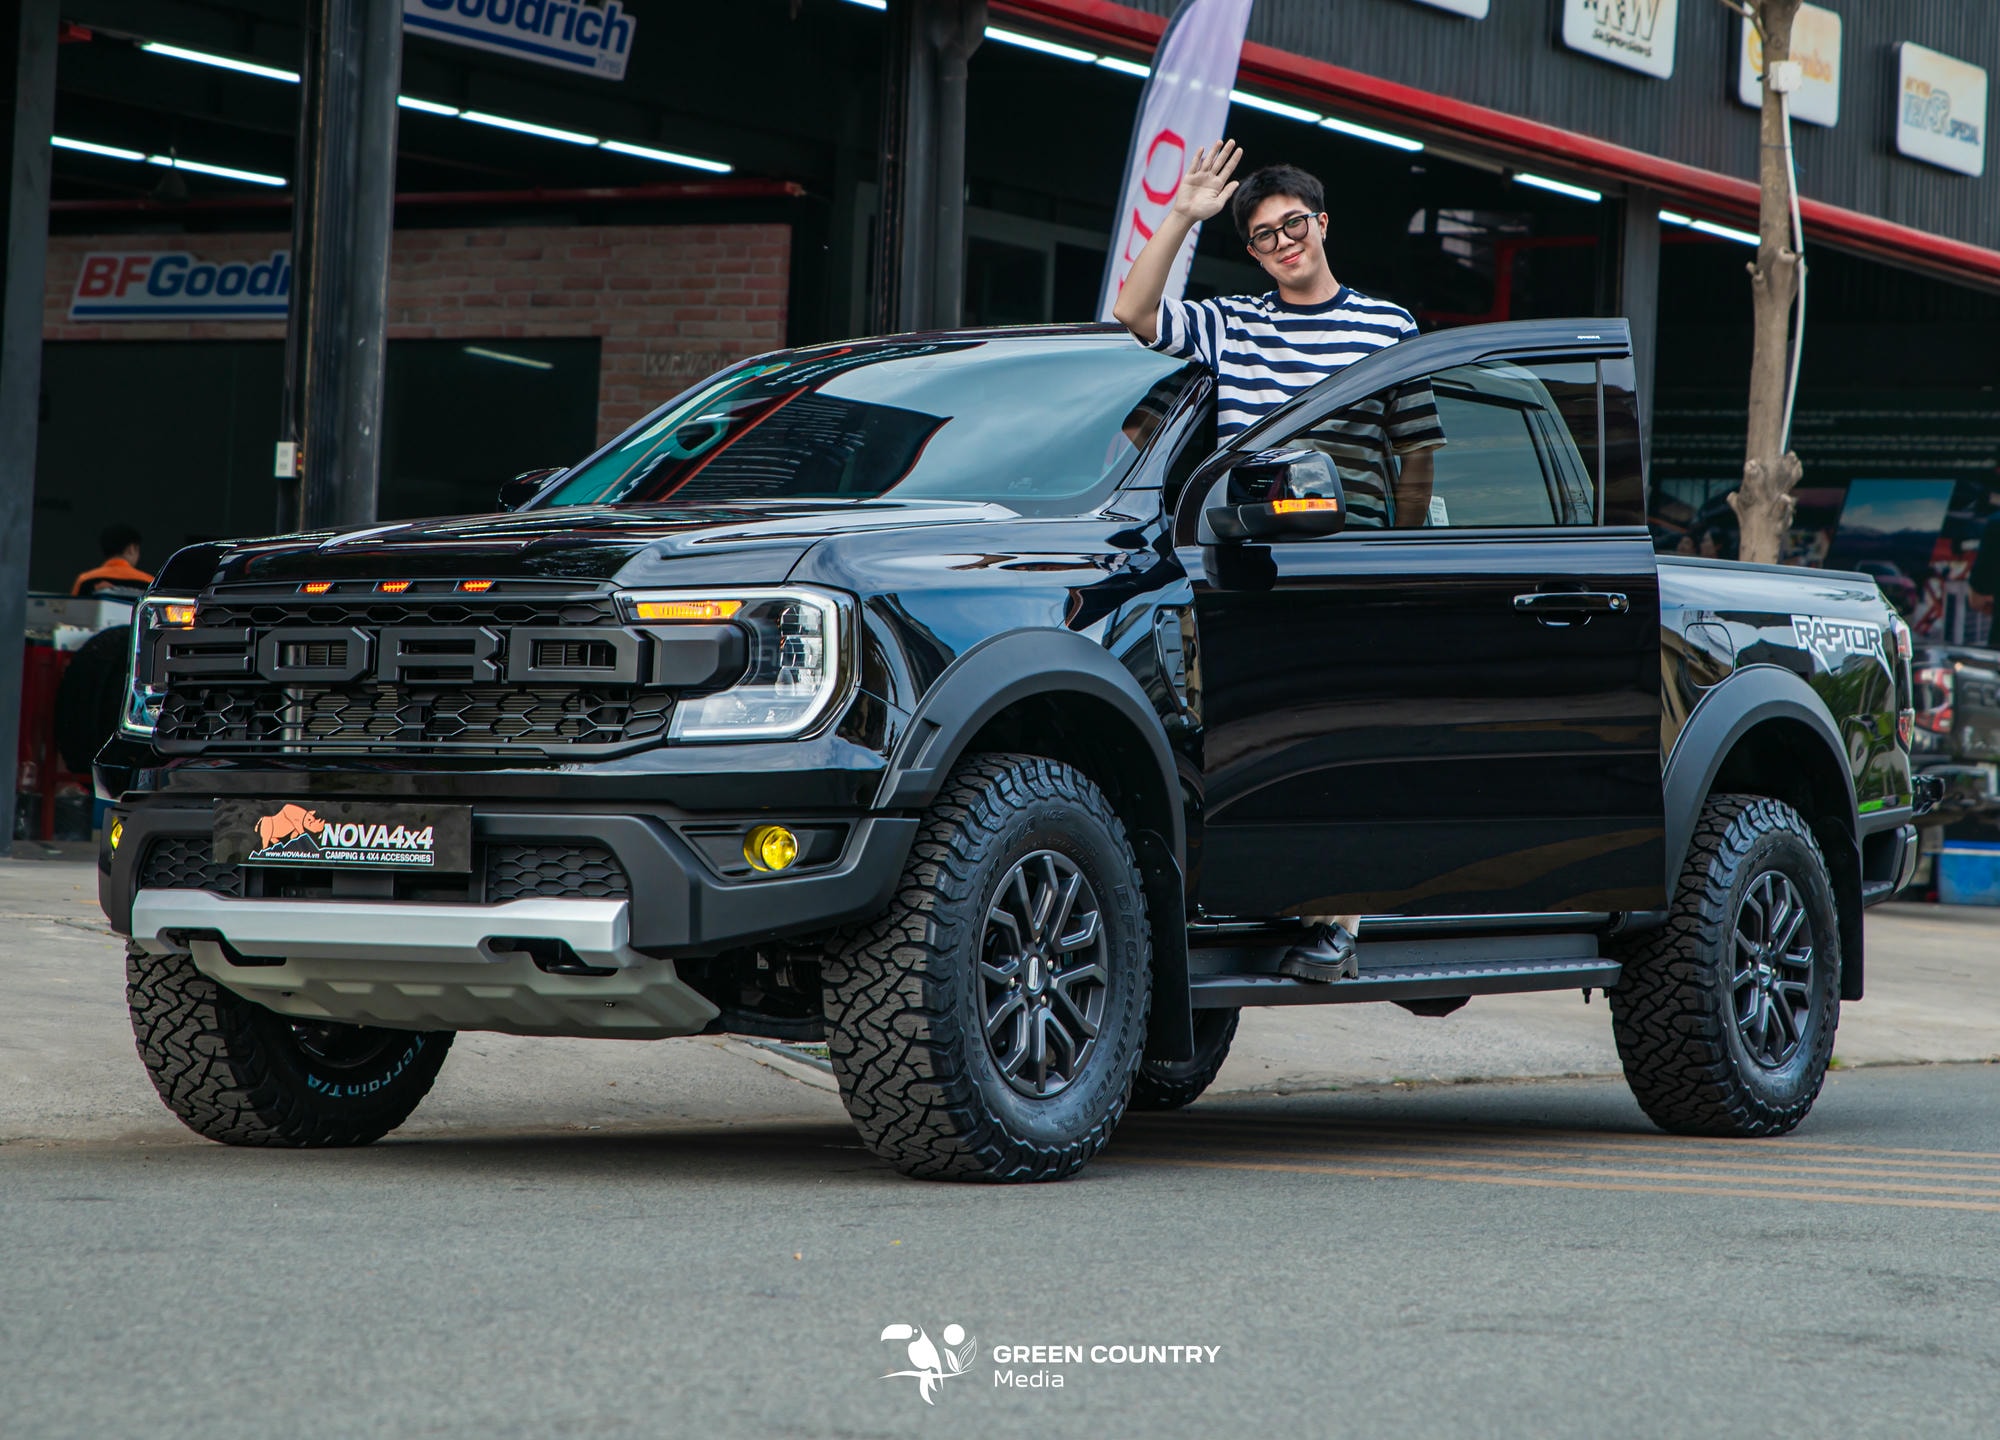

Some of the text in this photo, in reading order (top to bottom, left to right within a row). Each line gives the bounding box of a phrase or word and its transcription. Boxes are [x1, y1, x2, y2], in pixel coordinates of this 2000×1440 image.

[421, 0, 630, 54] oodrich
[149, 626, 655, 687] FORD
[1791, 614, 1890, 670] RAPTOR
[321, 823, 434, 850] NOVA4x4
[325, 851, 432, 863] CAMPING & 4X4 ACCESSORIES
